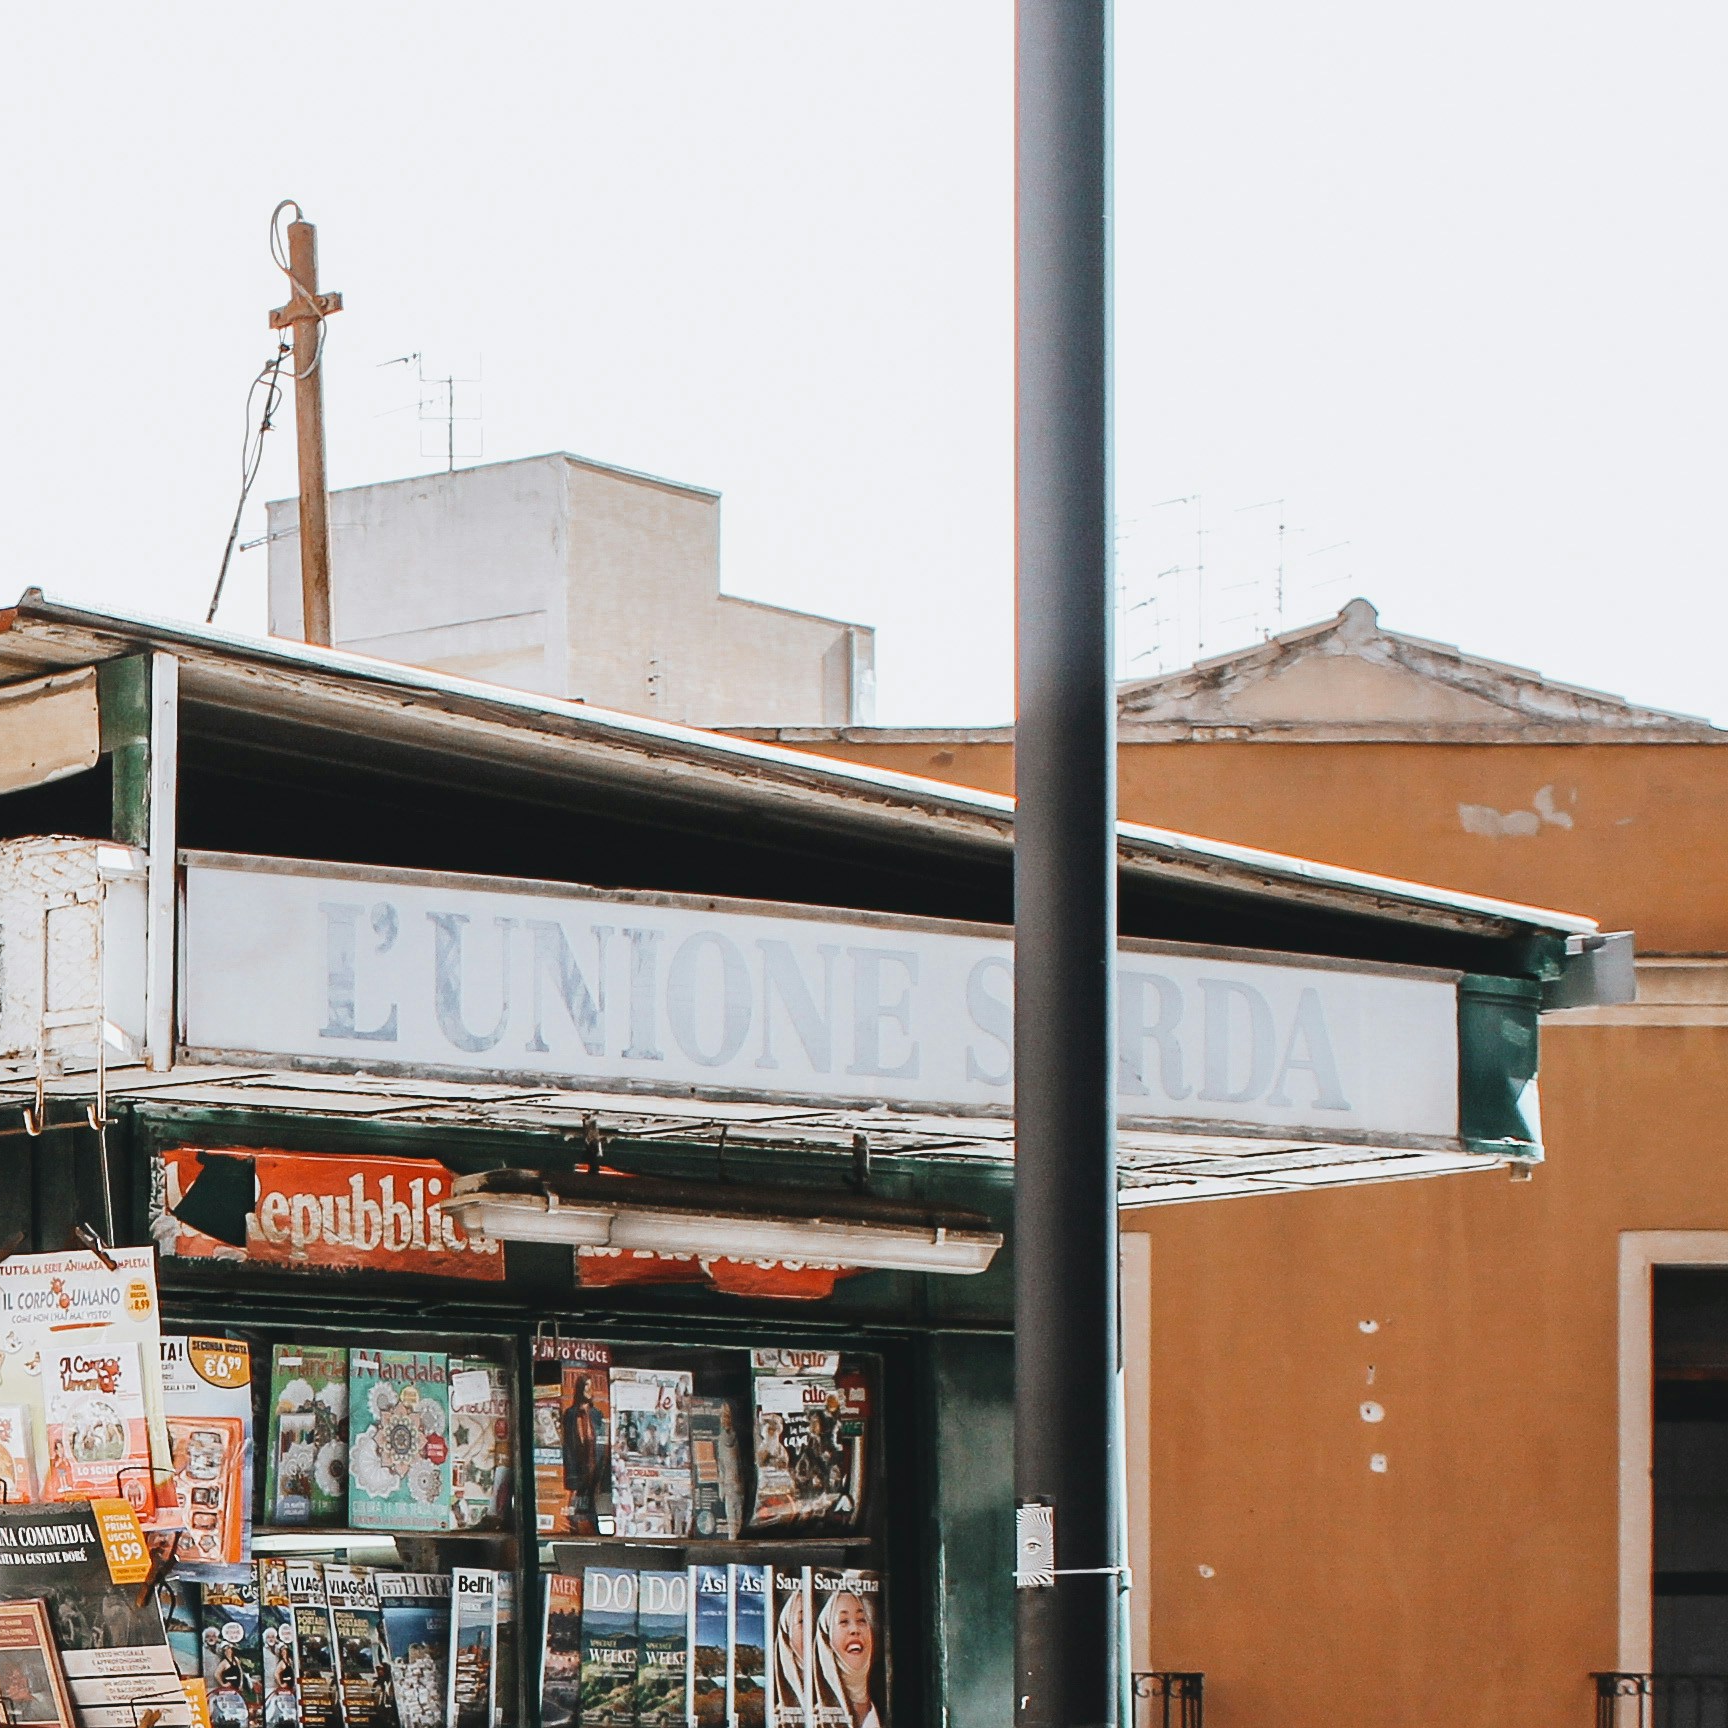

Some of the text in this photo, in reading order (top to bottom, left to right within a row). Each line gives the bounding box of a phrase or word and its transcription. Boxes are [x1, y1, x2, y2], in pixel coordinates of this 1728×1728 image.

[317, 900, 1351, 1113] L'UNIONE SRDA
[575, 1349, 608, 1364] CROCE
[18, 1523, 96, 1545] COMMEDIA
[813, 1573, 879, 1594] Sardegna
